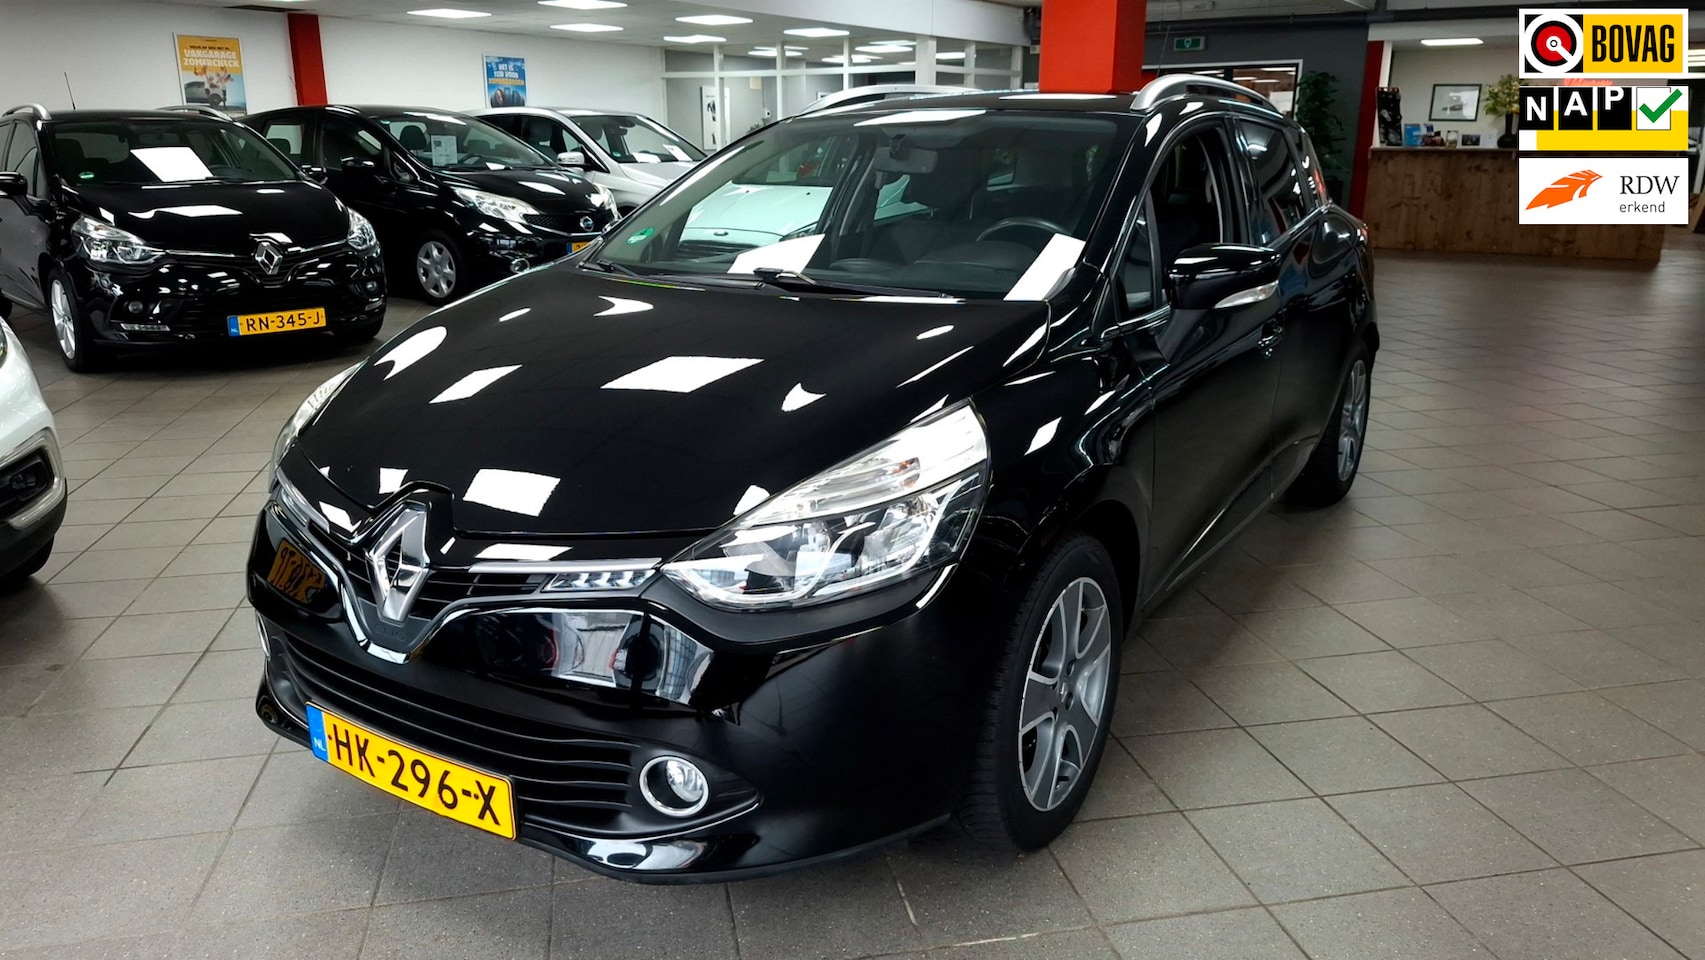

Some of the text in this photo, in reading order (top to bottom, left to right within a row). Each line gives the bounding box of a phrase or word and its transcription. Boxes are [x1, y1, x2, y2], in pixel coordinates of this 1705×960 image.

[184, 49, 237, 60] VAKGARAGE
[183, 58, 240, 67] ZOMERCHECK
[245, 311, 320, 331] RN-345-J
[313, 713, 501, 826] NL HK-296-X
